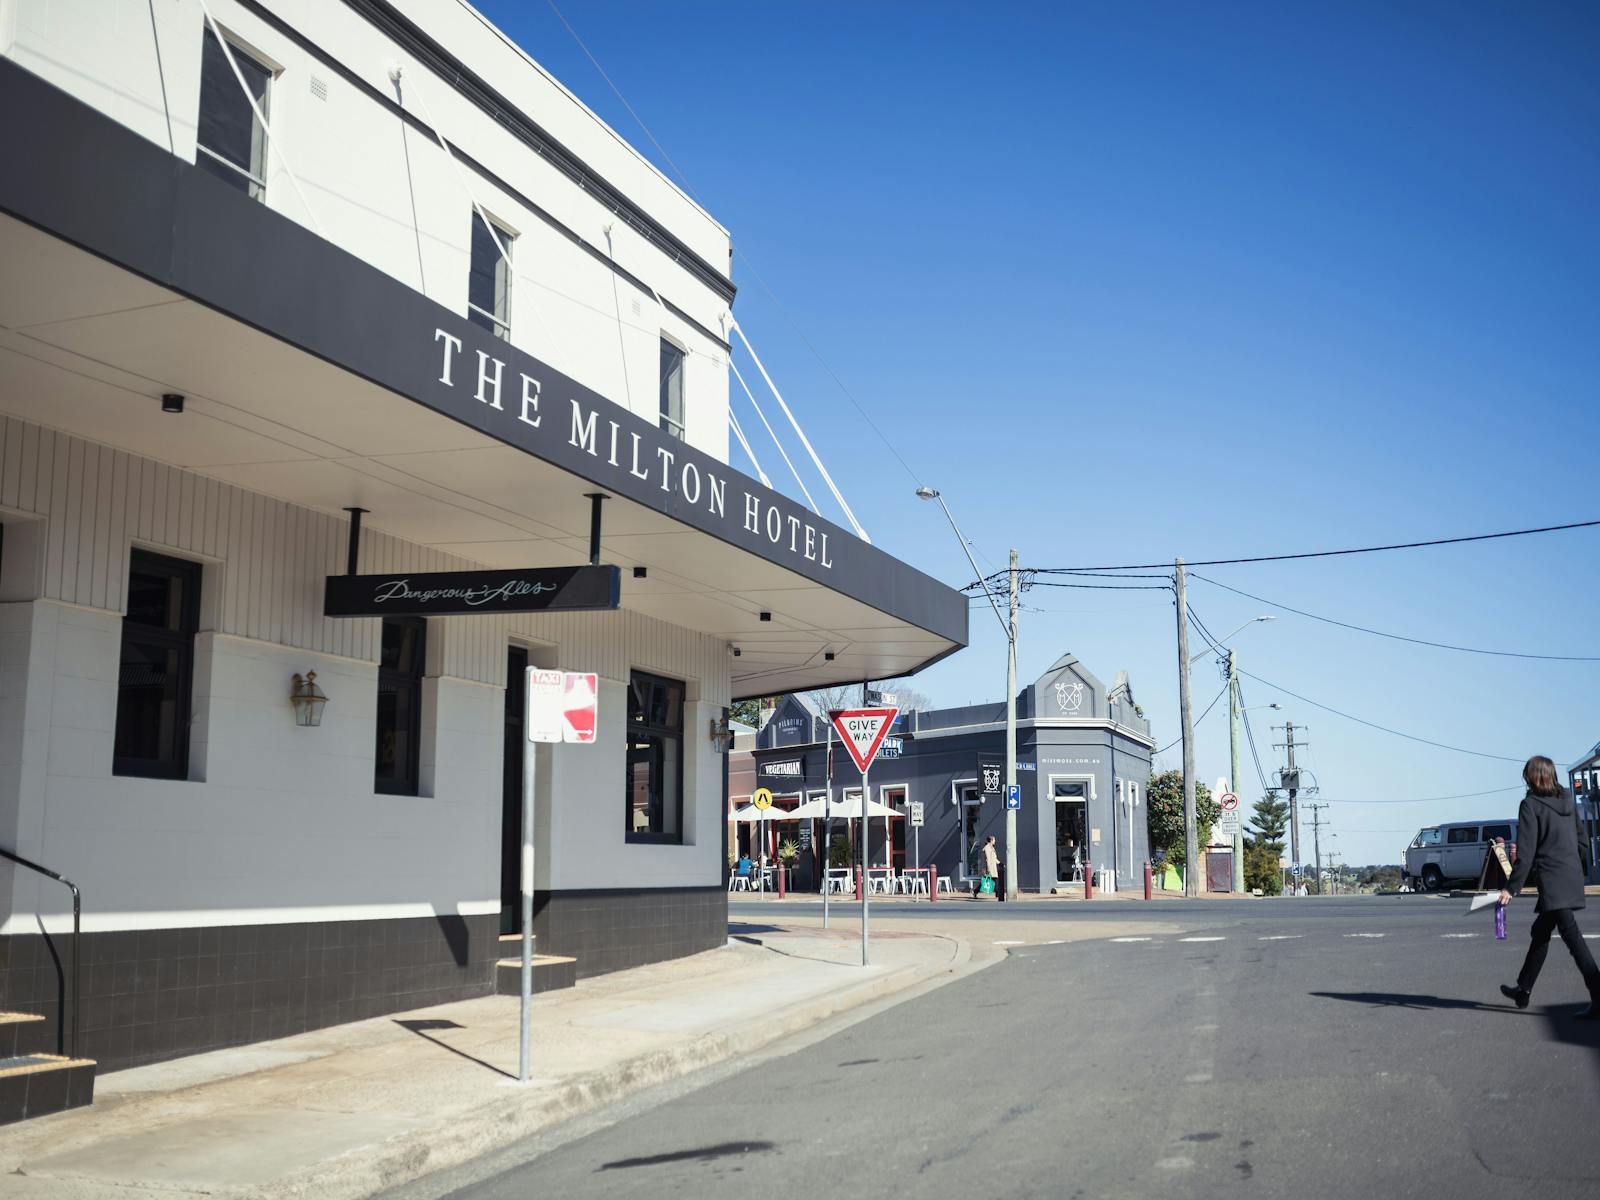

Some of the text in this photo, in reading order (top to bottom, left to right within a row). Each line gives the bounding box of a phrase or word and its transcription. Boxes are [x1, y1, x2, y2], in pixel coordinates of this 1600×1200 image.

[434, 328, 833, 569] THE MILTON HOTEL
[373, 579, 557, 606] Dangerous Ales
[848, 720, 878, 731] GIVE
[853, 733, 874, 741] WAY
[764, 761, 801, 775] VEGETARIAN
[1010, 787, 1017, 797] P
